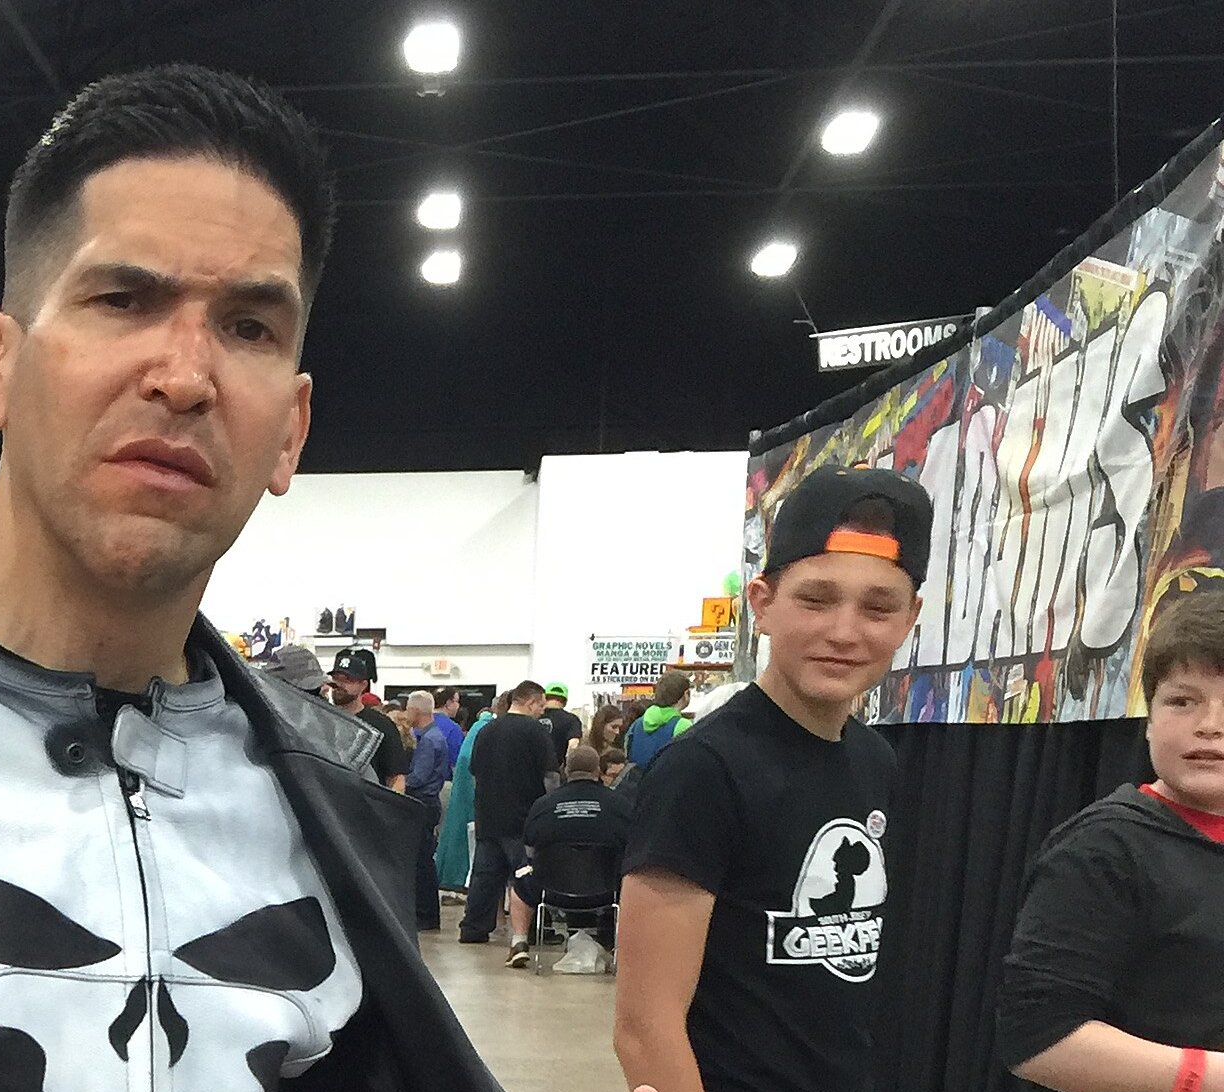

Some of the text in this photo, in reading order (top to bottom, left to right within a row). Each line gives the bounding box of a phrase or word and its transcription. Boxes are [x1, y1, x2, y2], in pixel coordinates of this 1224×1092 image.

[819, 323, 957, 368] RESTROOMS
[592, 641, 672, 650] GRAPHIC NOVELS
[591, 675, 601, 683] AS
[602, 675, 638, 683] STICKERED
[639, 675, 649, 683] ON
